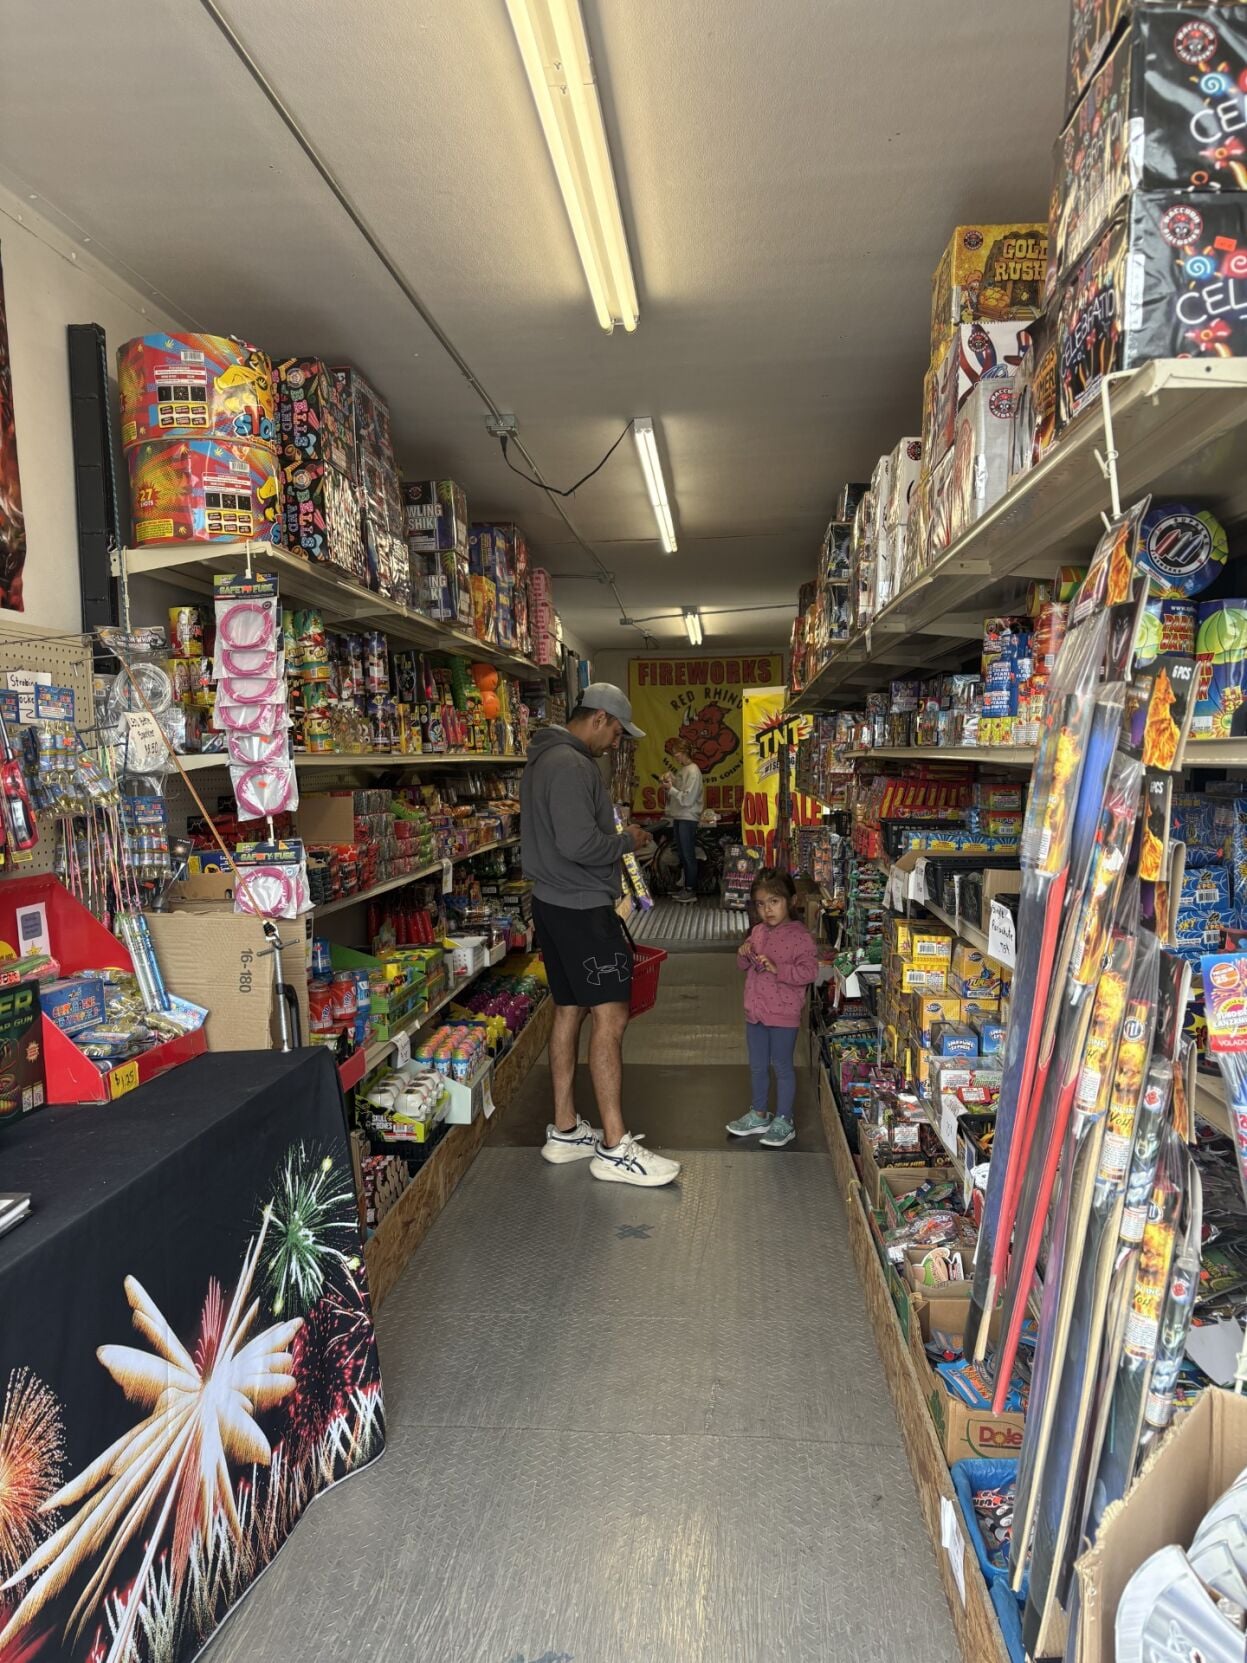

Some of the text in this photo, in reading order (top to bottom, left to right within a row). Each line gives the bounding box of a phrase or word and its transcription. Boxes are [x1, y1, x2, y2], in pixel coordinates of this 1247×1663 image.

[638, 658, 772, 686] FIREWORKS
[670, 690, 695, 712] RED
[759, 719, 801, 759] TNT
[744, 791, 769, 826] ON
[775, 791, 822, 826] ALE
[239, 947, 253, 994] 16-180
[979, 1426, 1024, 1446] Dole
